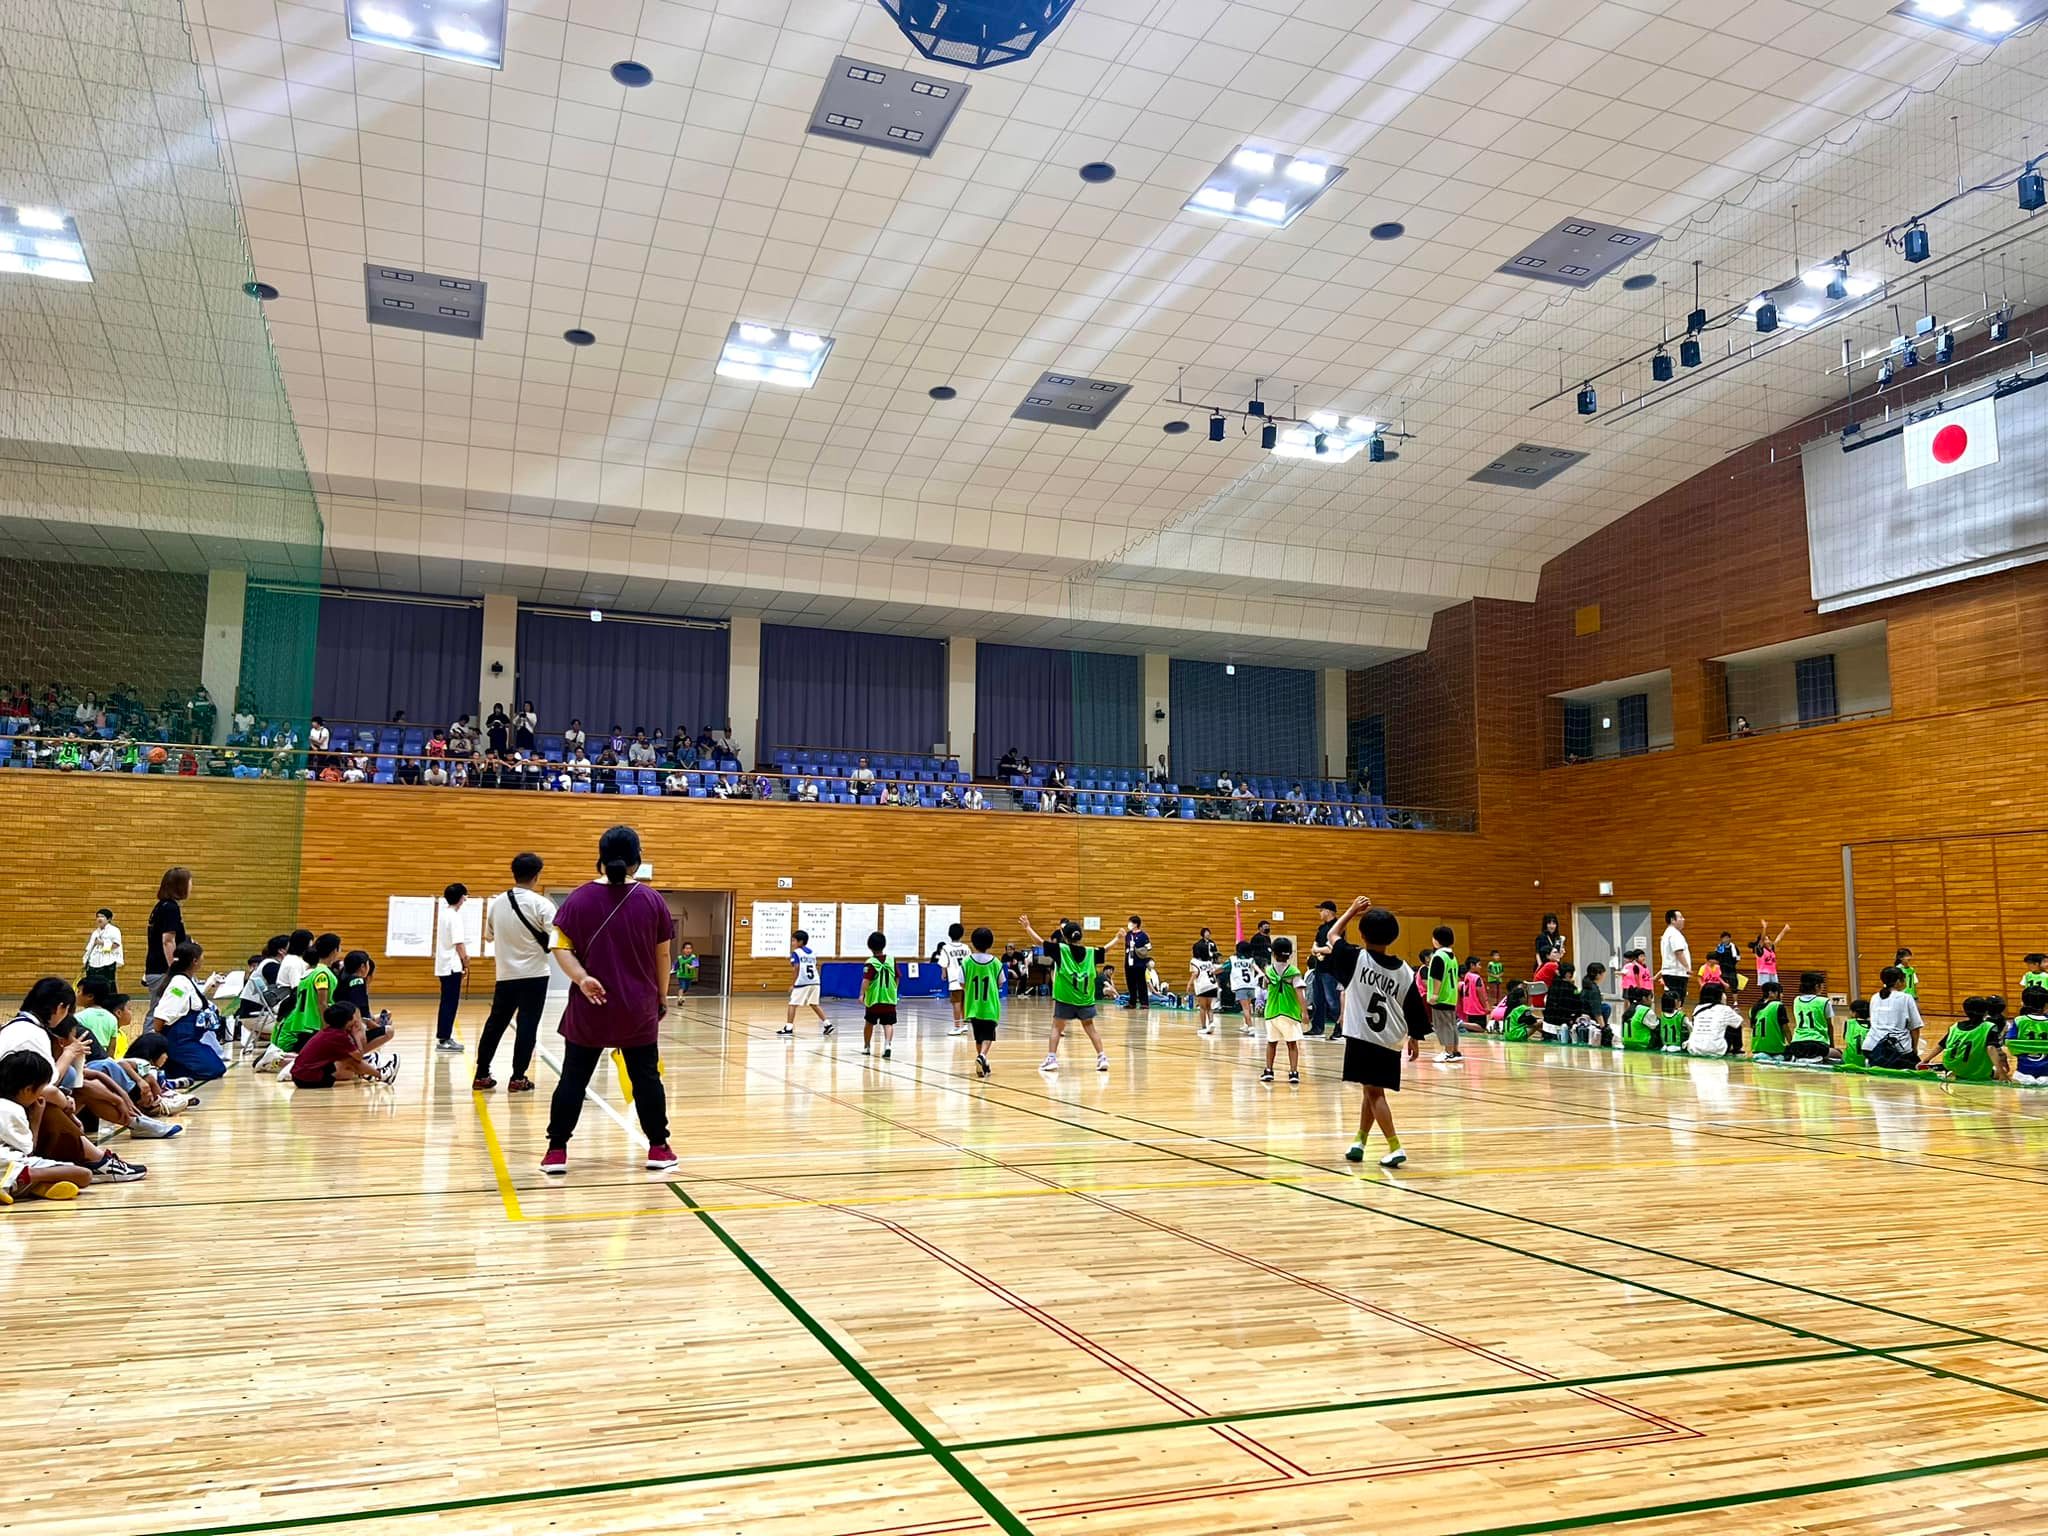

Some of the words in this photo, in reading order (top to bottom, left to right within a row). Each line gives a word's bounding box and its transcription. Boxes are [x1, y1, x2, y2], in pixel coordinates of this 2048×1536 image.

[806, 965, 815, 980] 5
[1071, 972, 1089, 995] 11
[1242, 968, 1251, 983] 5
[1360, 967, 1400, 1001] KOKURA
[972, 975, 990, 1002] 11
[1366, 992, 1387, 1033] 5
[1798, 1010, 1815, 1029] 11
[1664, 1024, 1677, 1043] 11
[1950, 1040, 1972, 1063] 11
